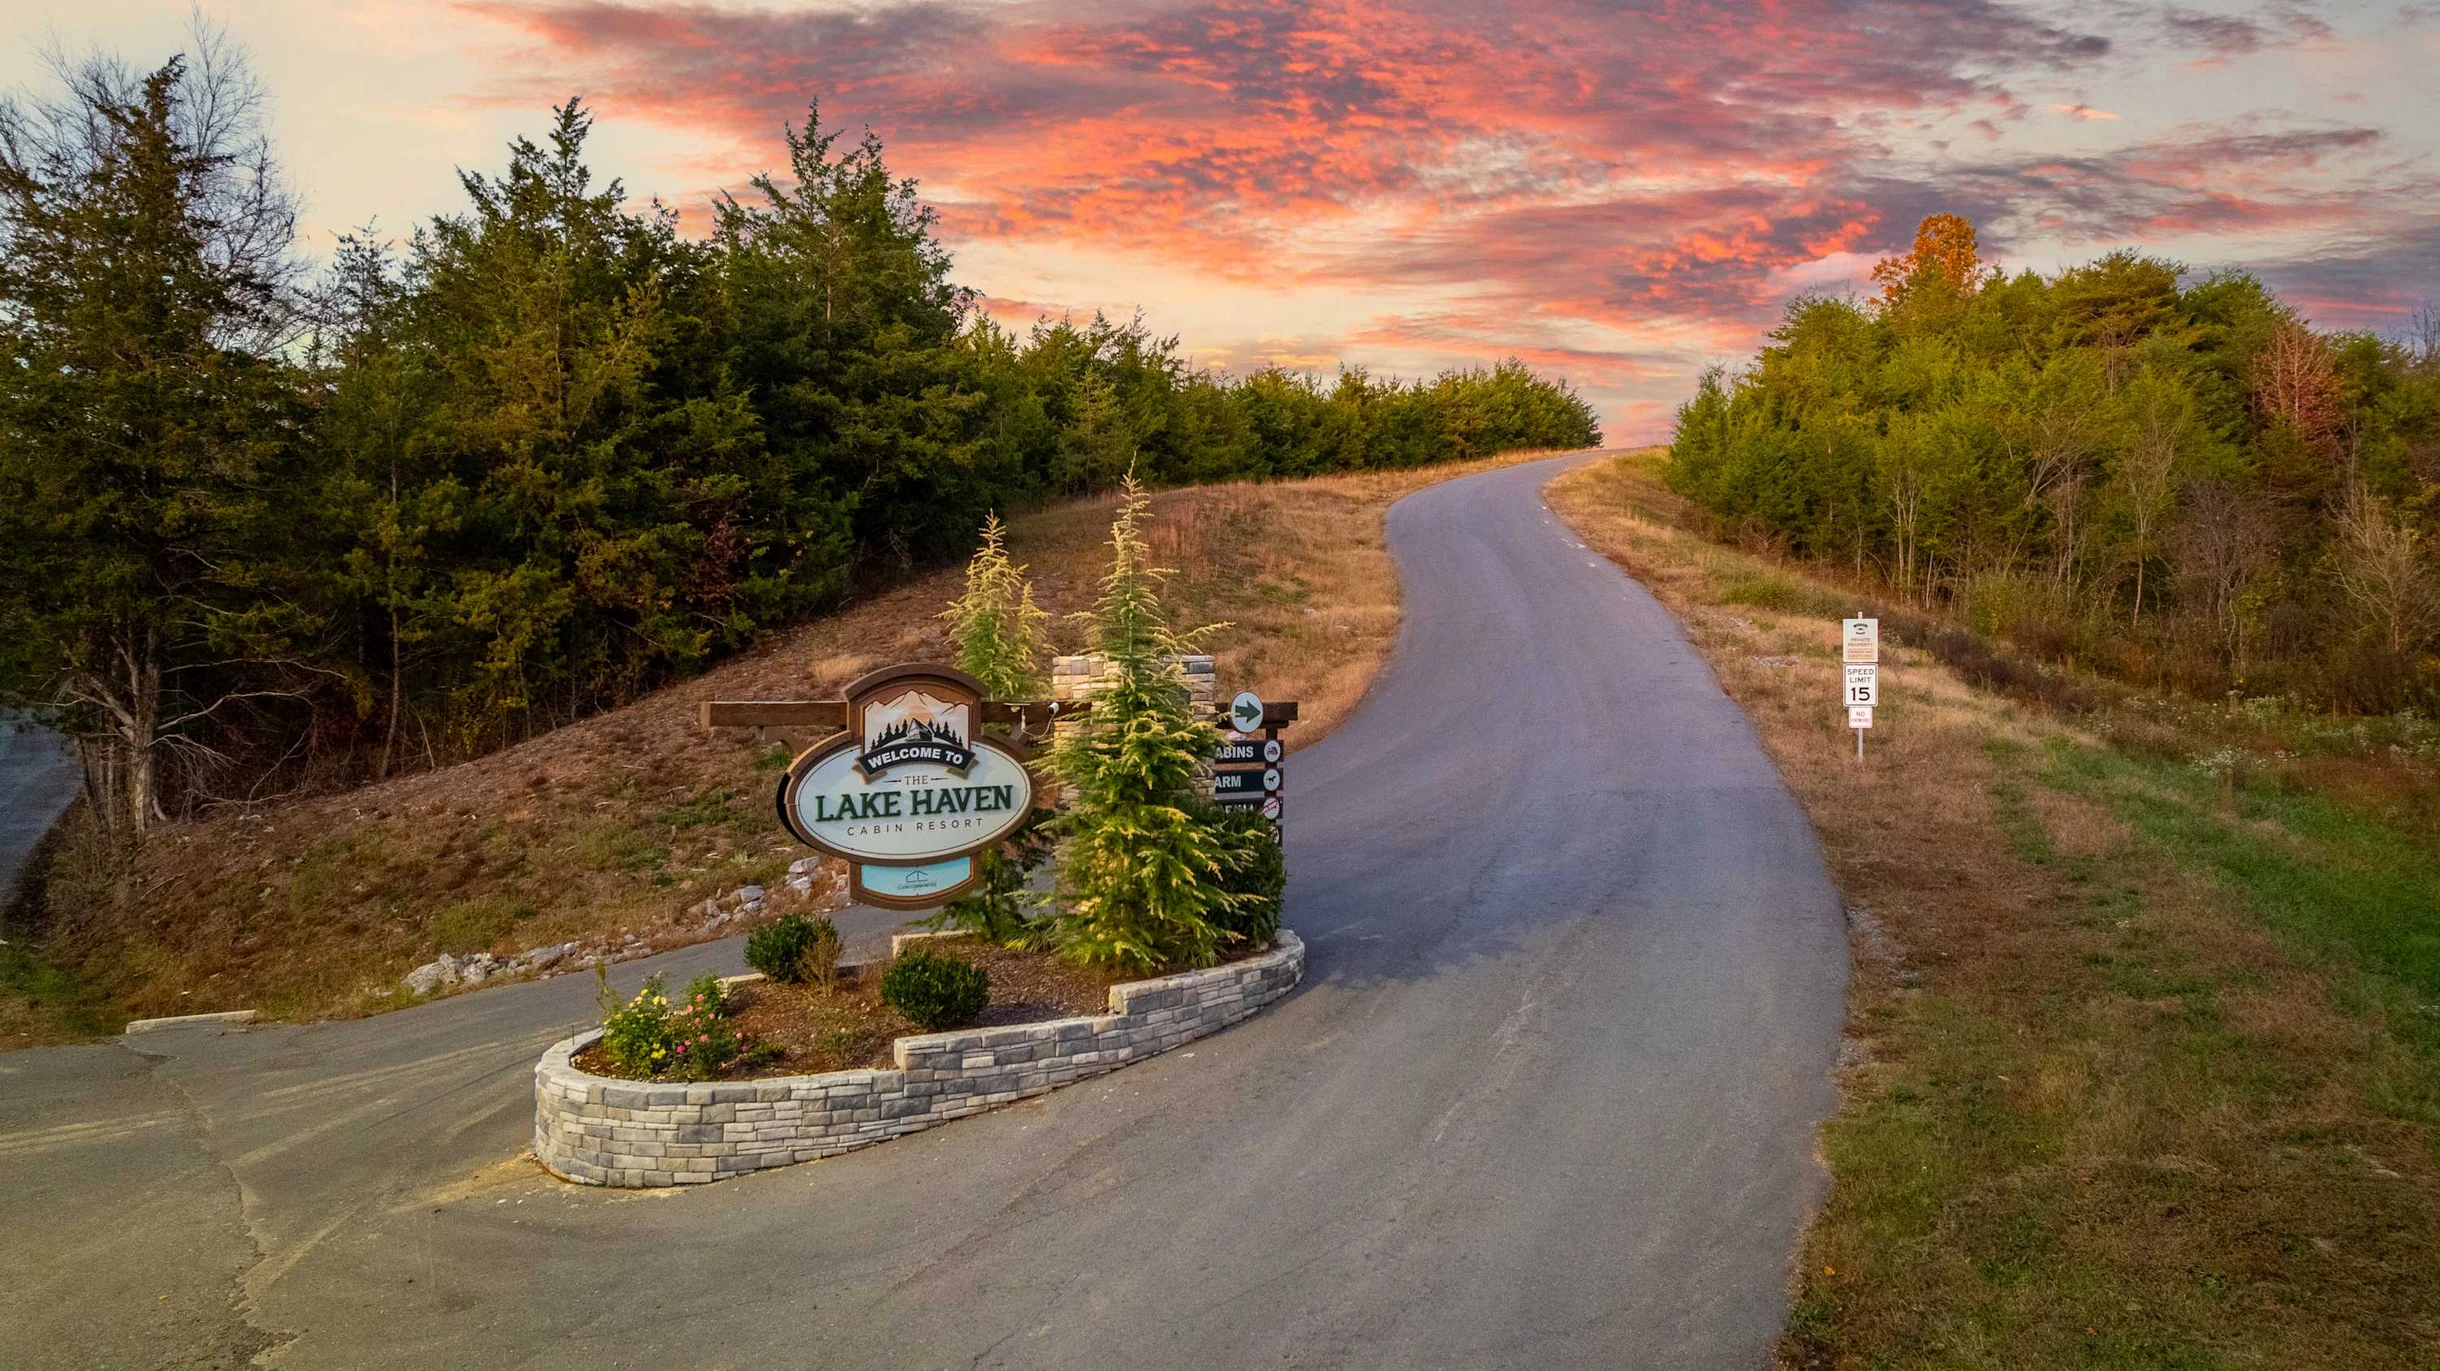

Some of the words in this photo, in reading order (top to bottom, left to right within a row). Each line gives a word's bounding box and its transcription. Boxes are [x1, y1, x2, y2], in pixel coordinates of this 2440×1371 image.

[1851, 687, 1870, 701] 15
[868, 747, 942, 769] WELCOME
[945, 751, 964, 765] TO
[1215, 746, 1253, 759] ABINS
[904, 775, 929, 786] THE
[1214, 775, 1241, 788] ARM
[815, 791, 902, 822] LAKE
[910, 784, 1013, 816] HAVEN
[847, 823, 904, 836] CABIN
[916, 818, 983, 831] RESORT
